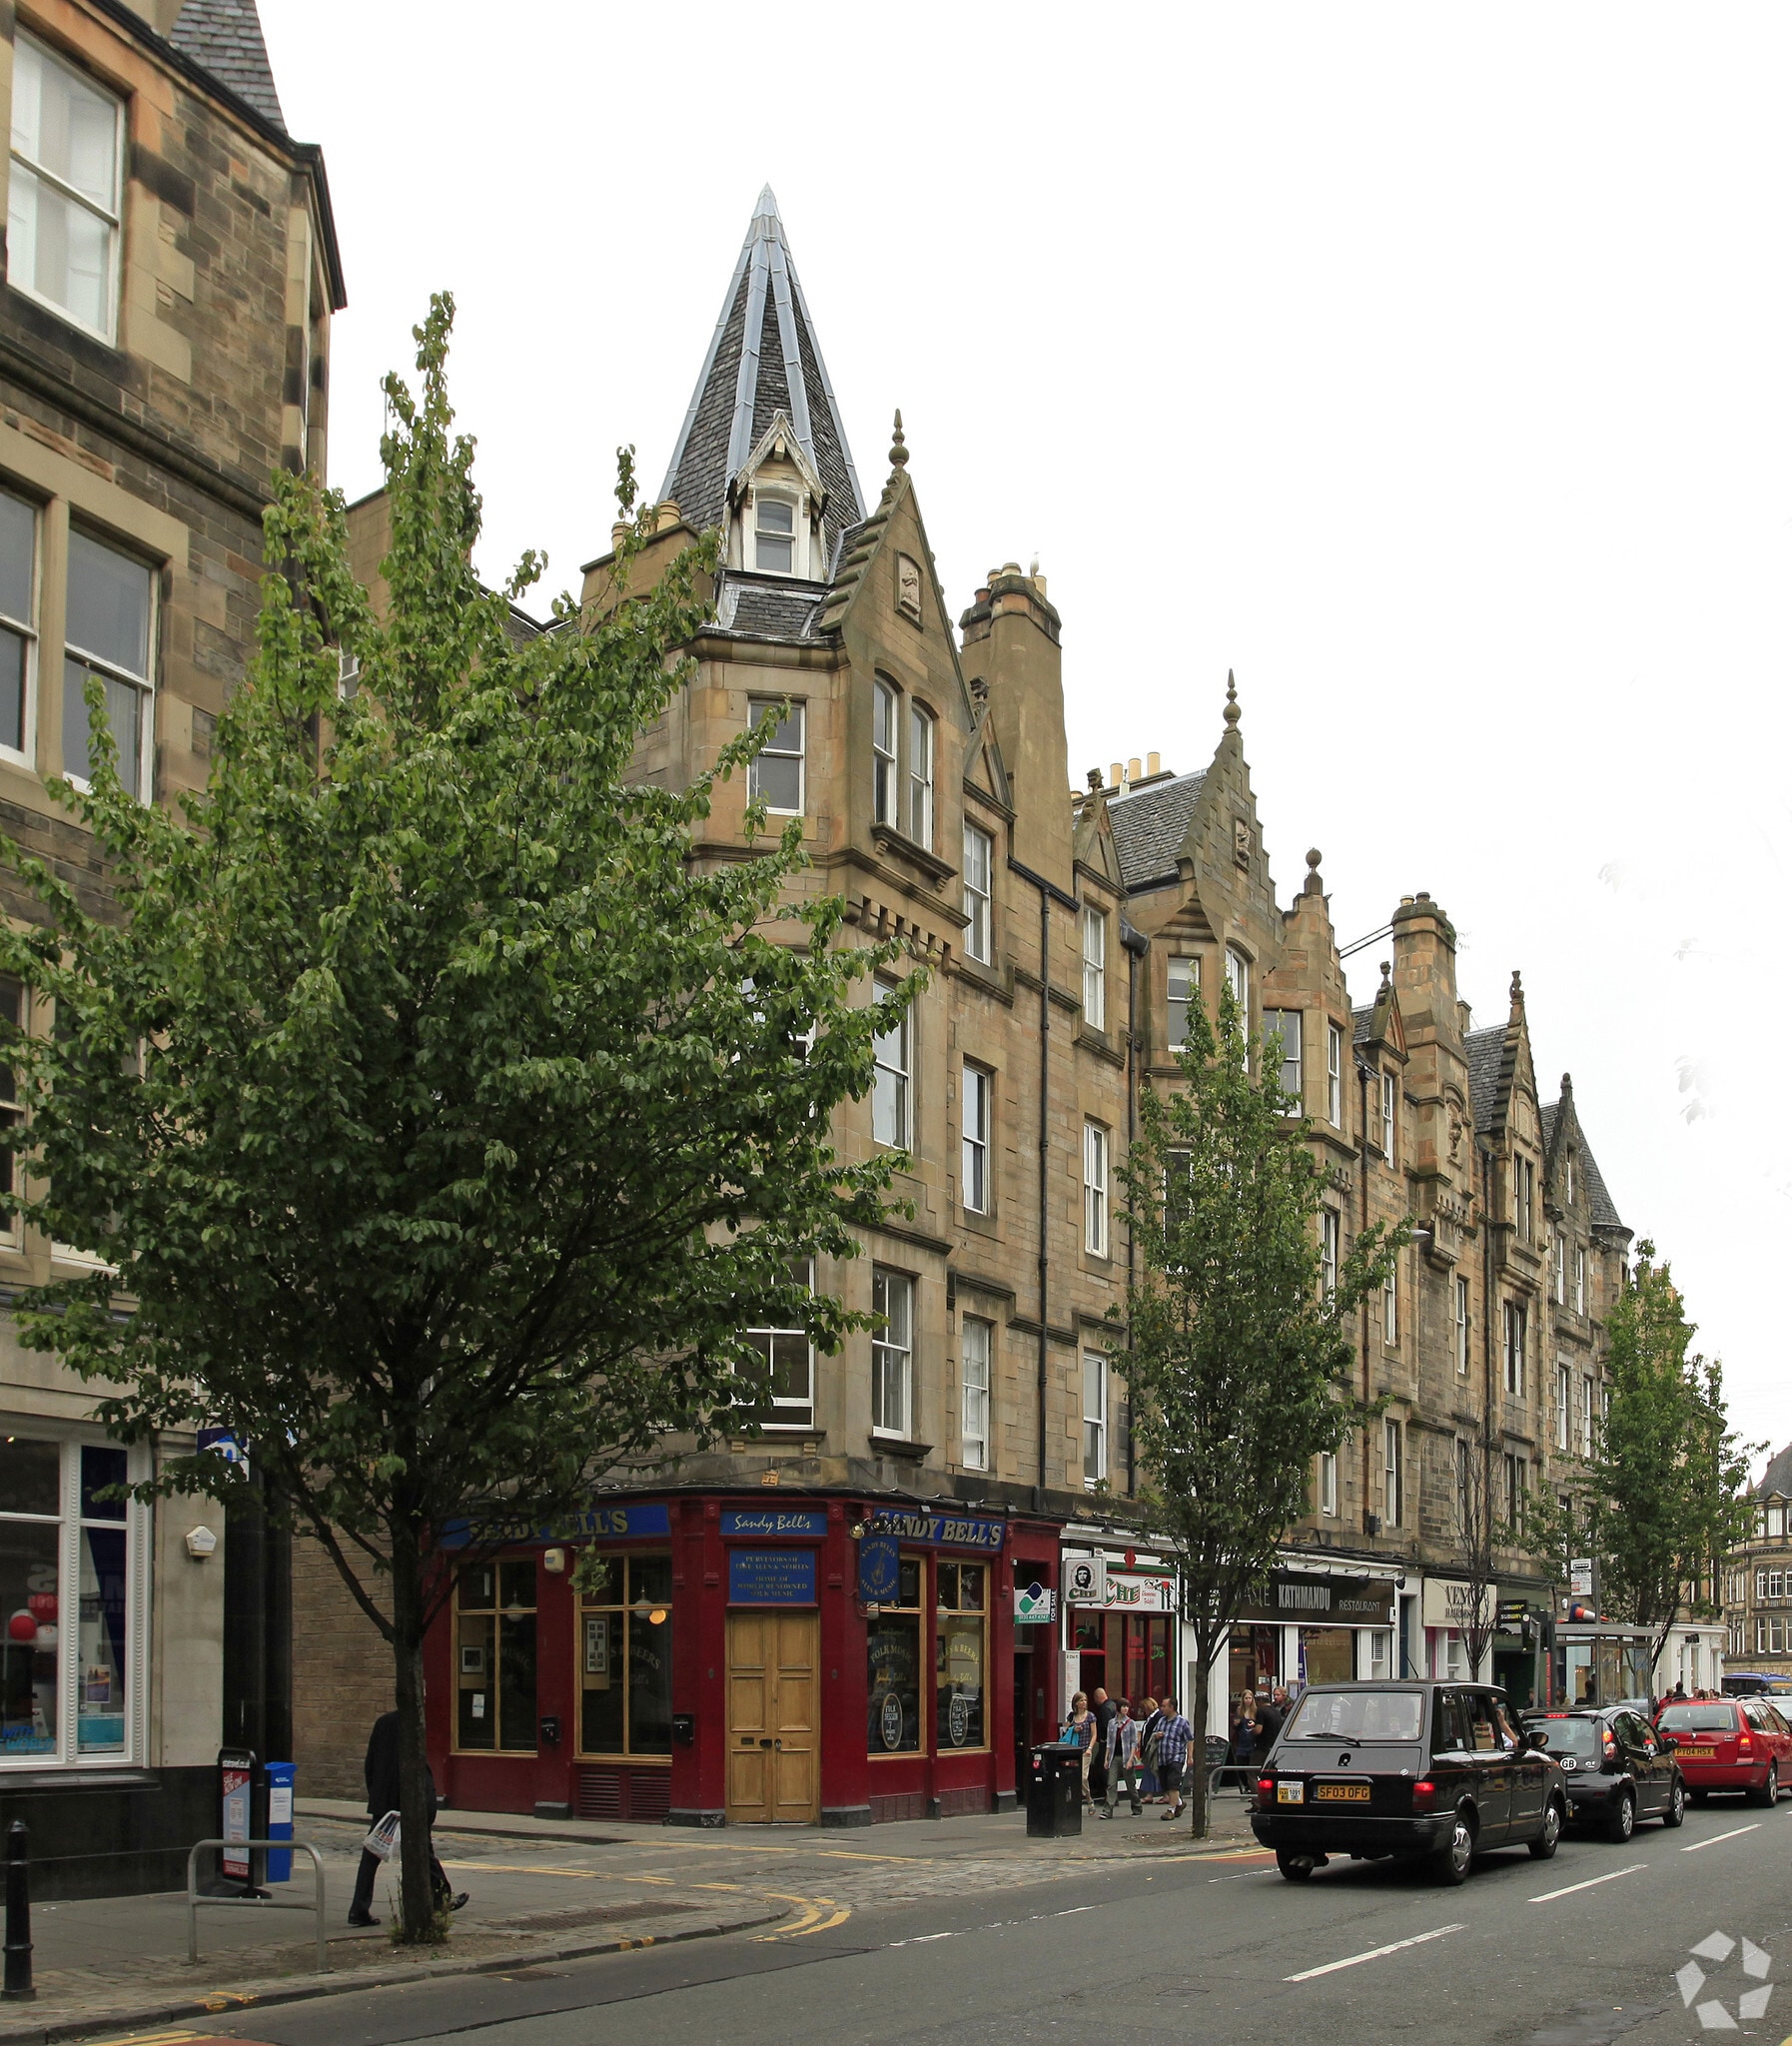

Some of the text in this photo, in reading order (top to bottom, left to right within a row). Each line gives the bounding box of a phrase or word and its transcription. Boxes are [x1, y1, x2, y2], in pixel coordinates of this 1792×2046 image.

[734, 1515, 811, 1534] Sandy Bell's
[942, 1520, 1002, 1546] BELL'S
[1278, 1583, 1332, 1611] KATHMANDU
[1339, 1599, 1380, 1612] RESTAURANT
[871, 1644, 889, 1663] FOLK
[2, 1725, 35, 1738] WITH
[1562, 1759, 1575, 1768] GB
[1320, 1787, 1368, 1798] SF03 OFG
